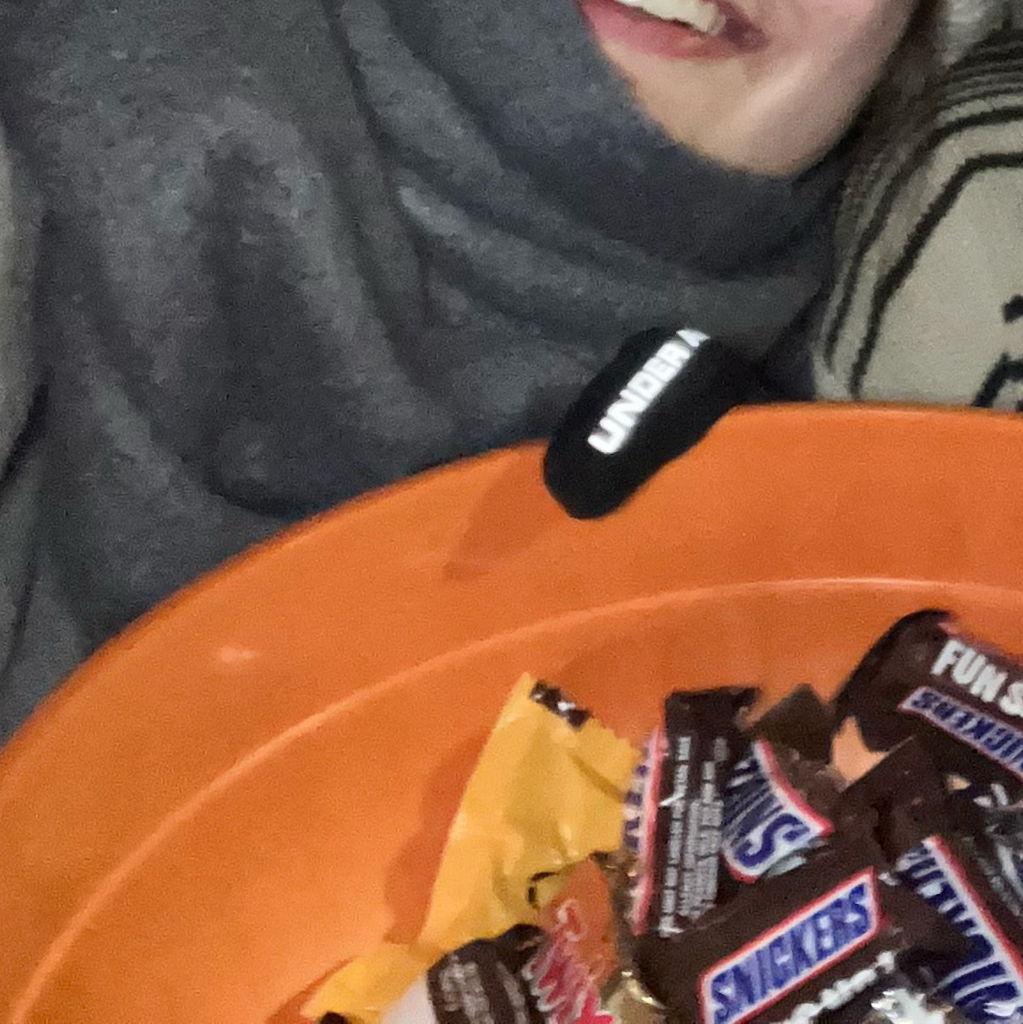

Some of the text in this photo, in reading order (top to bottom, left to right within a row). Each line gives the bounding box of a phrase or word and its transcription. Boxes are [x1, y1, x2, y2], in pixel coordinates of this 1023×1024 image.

[588, 340, 691, 453] UNDER
[930, 639, 1009, 703] FUN
[711, 880, 875, 1024] SNICKERS
